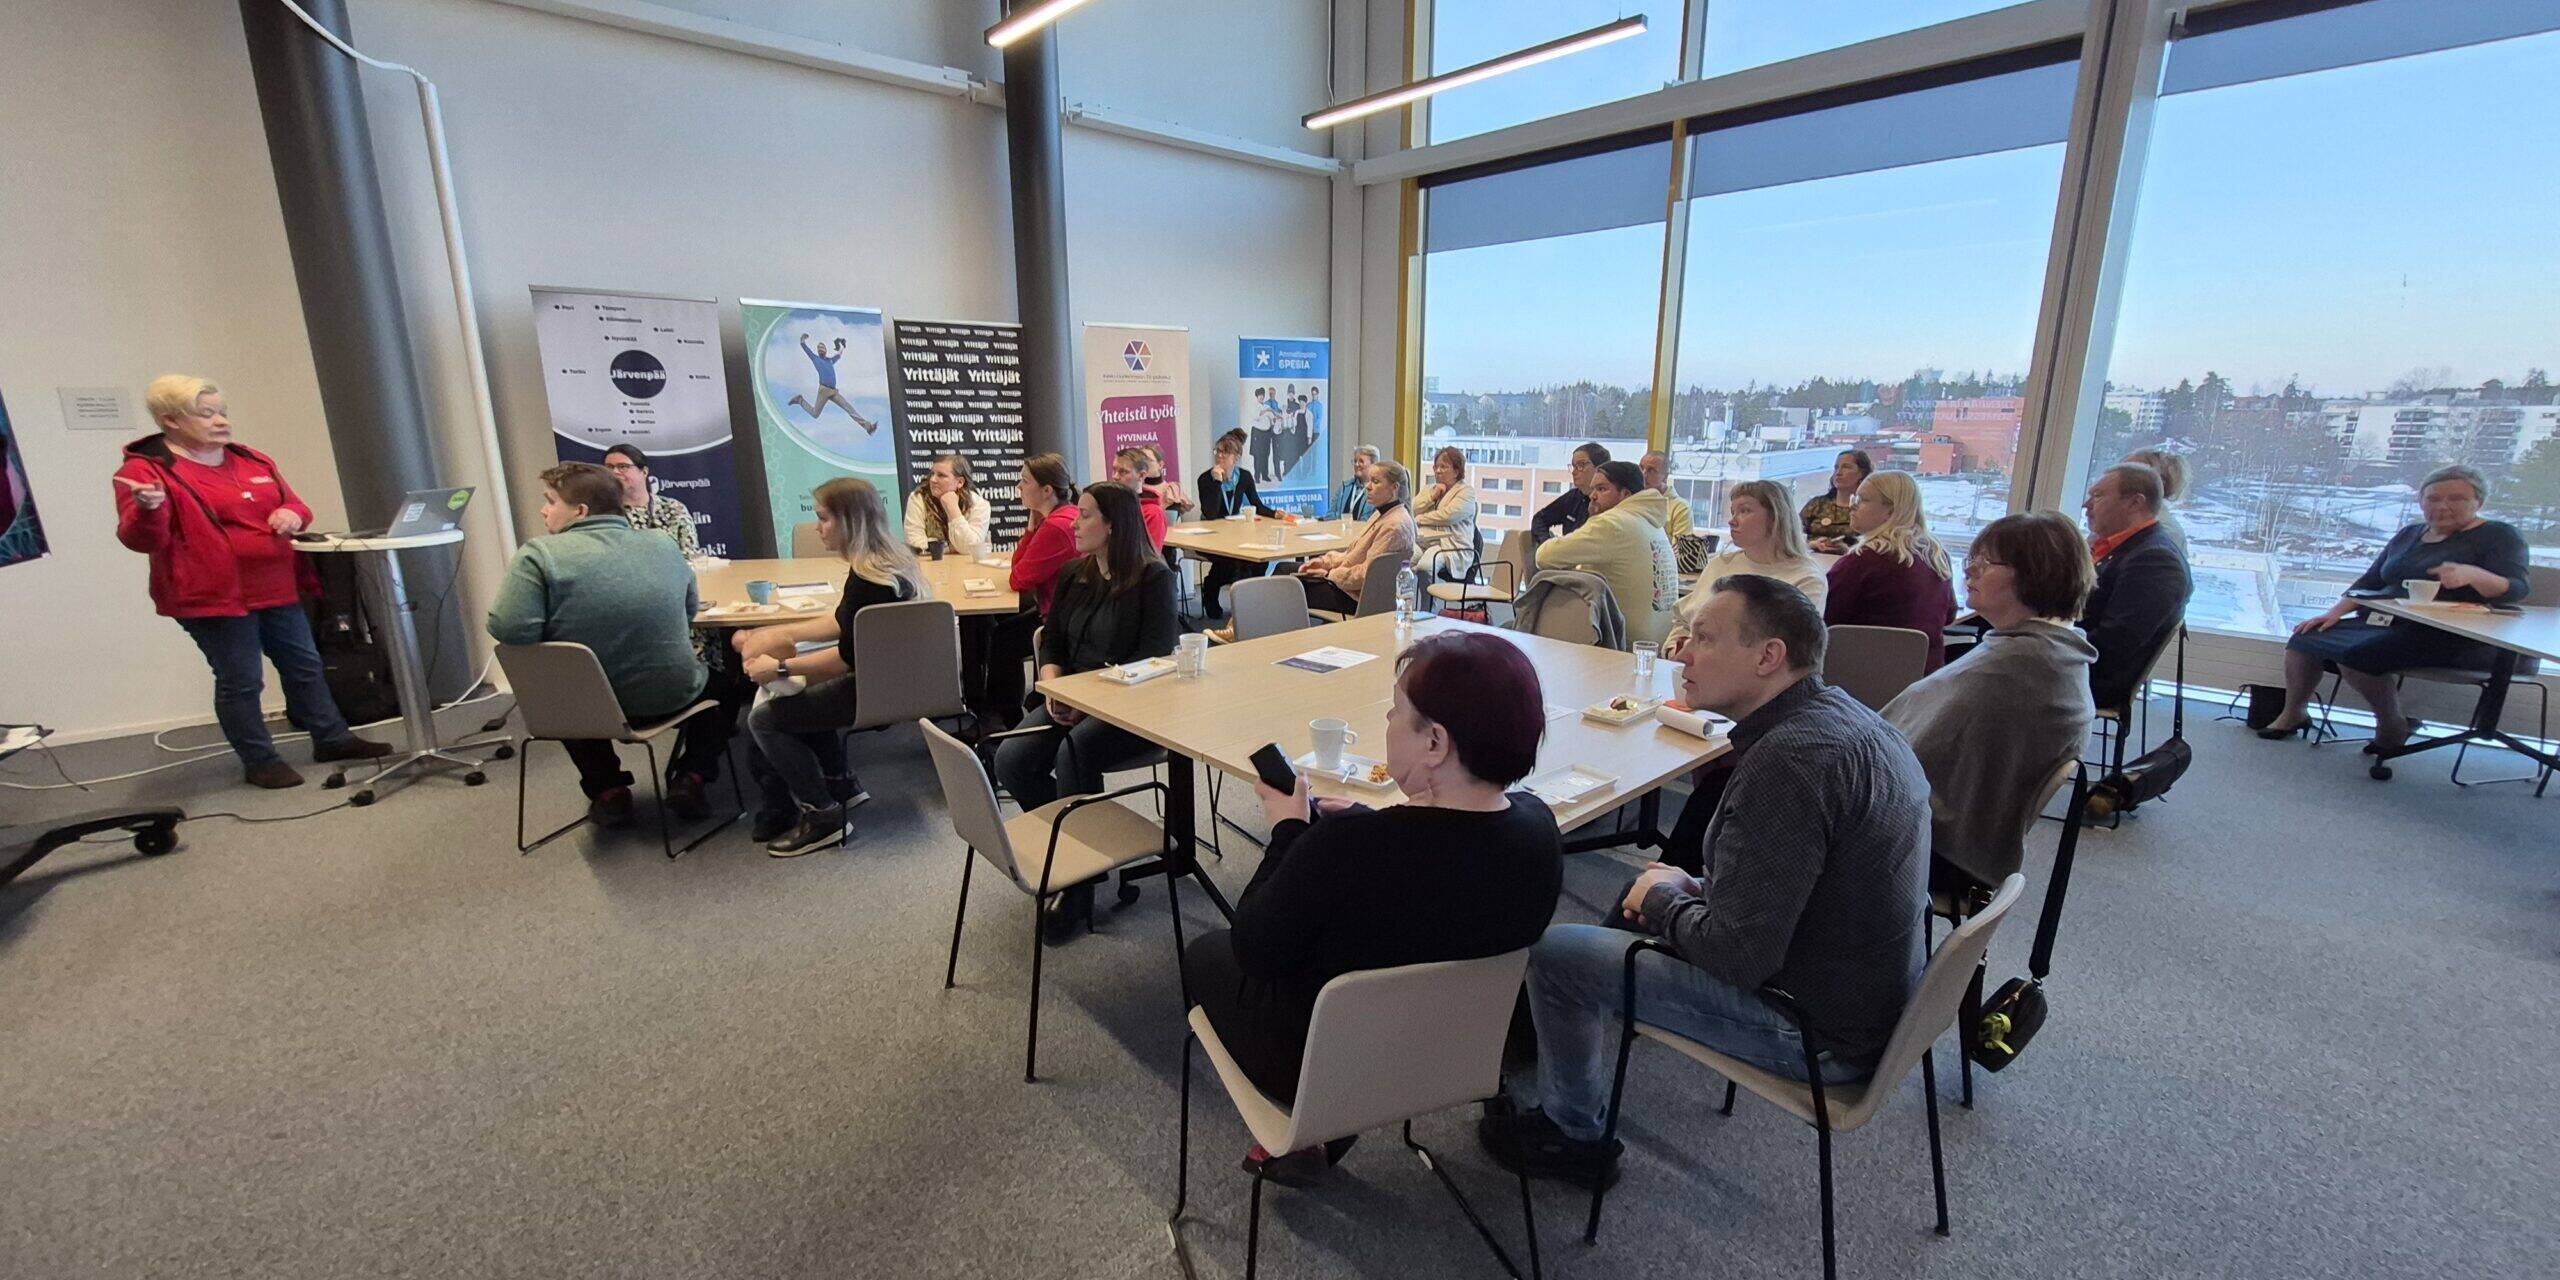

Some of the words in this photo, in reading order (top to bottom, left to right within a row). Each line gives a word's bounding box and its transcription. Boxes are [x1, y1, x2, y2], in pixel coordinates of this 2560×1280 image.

[901, 338, 928, 347] Yrittäjät
[933, 339, 959, 348] Yrittäjät
[963, 341, 989, 350] Yrittäjät
[993, 342, 1018, 351] Yrittäjät
[902, 352, 939, 363] Yrittäjät
[945, 353, 979, 364] Yrittäjät
[985, 354, 1019, 366] Yrittäjät
[611, 369, 666, 381] Järvenpää
[903, 367, 960, 384] Yrittäjät
[968, 369, 1020, 385] Yrittäjät
[906, 400, 933, 409] Yrittäjät
[938, 401, 964, 409] Yrittäjät
[967, 401, 993, 409] Yrittäjät
[996, 401, 1022, 409] Yrittäjät
[907, 414, 944, 425] Yrittäjät
[949, 414, 984, 425] Yrittäjät
[989, 414, 1023, 425] Yrittäjät
[1096, 406, 1147, 424] Yhteistä
[1150, 404, 1180, 423] työtä
[908, 428, 964, 445] Yrittäjät
[972, 428, 1024, 444] Yrittäjät
[1116, 431, 1158, 442] HYVINKÄÄ
[661, 478, 711, 491] järvenpää
[977, 486, 1021, 501] Yrittäjä
[1295, 493, 1323, 502] VOIMA
